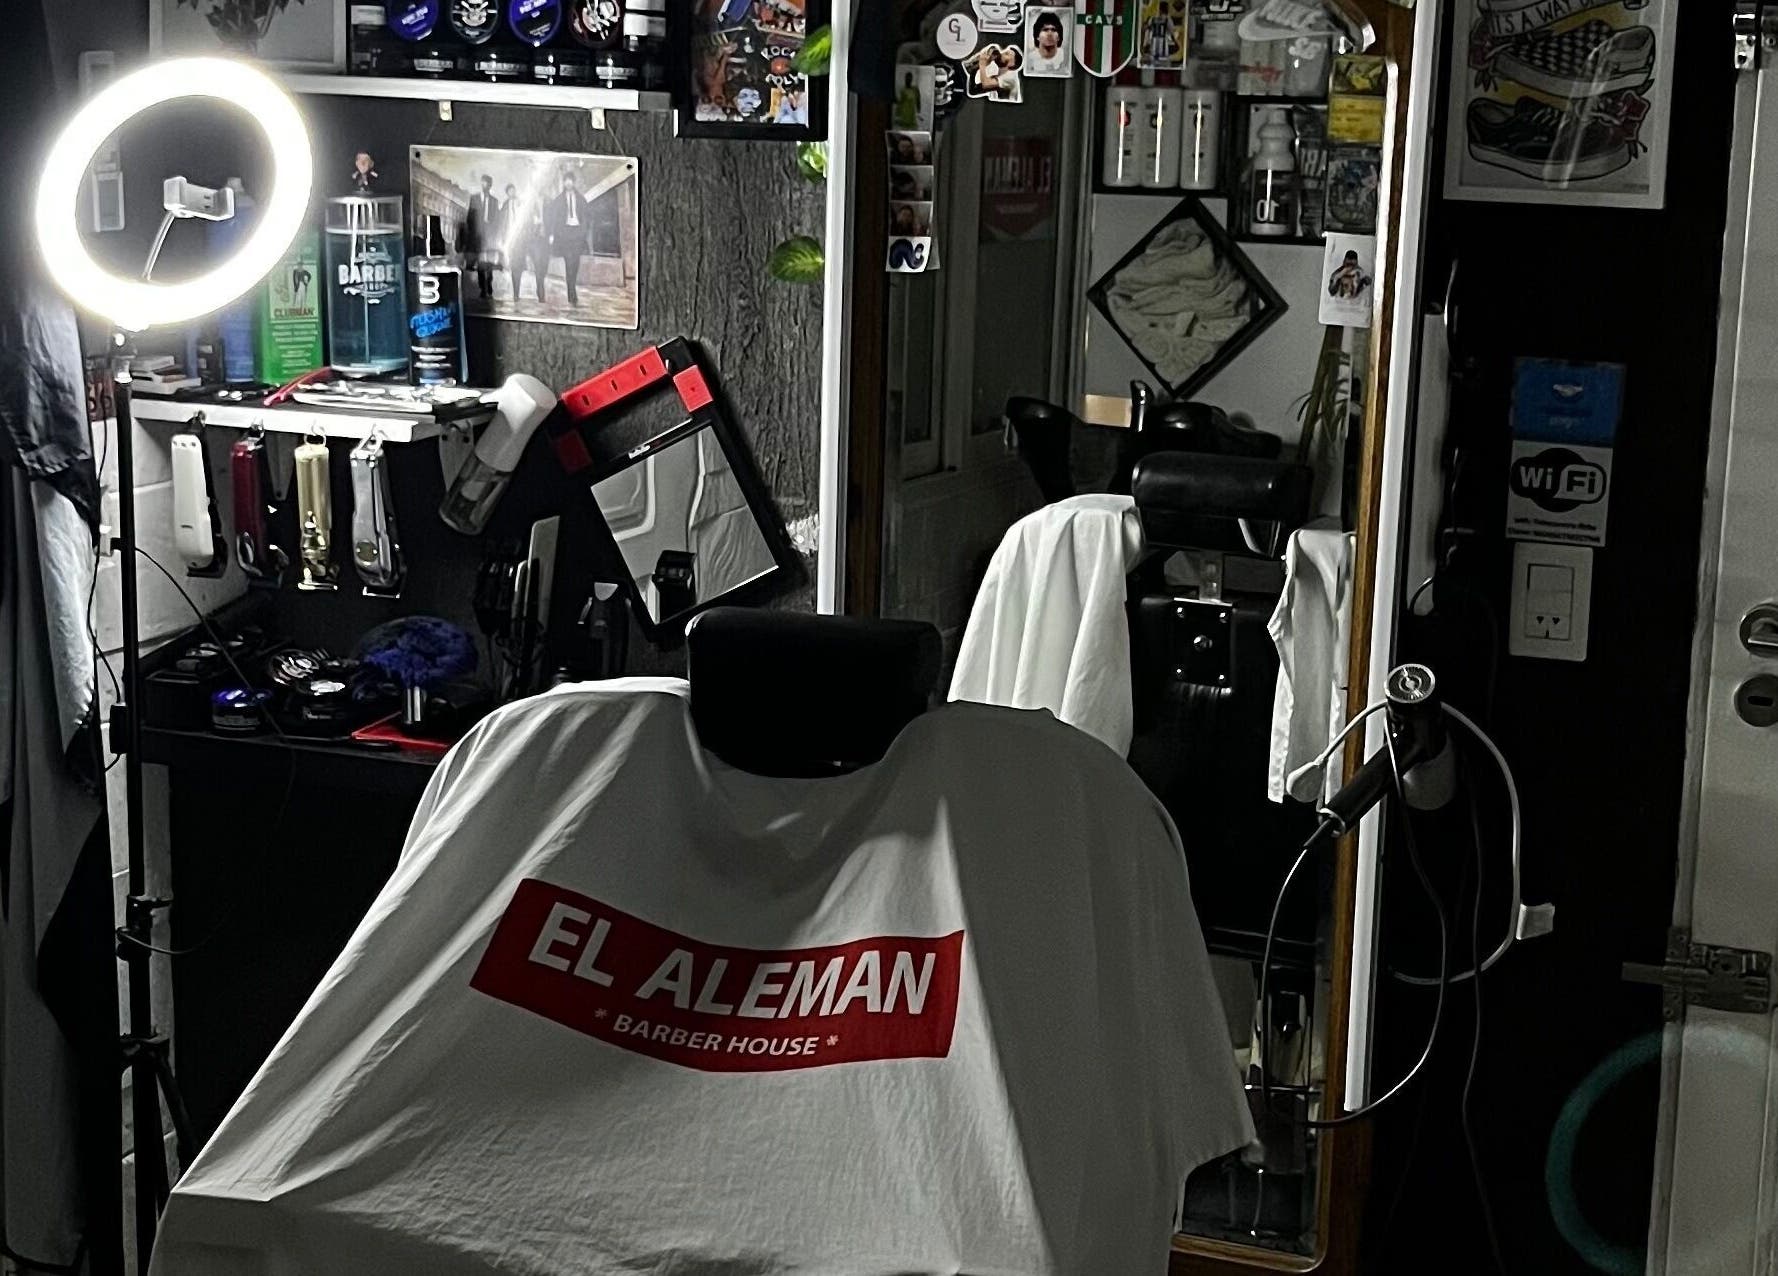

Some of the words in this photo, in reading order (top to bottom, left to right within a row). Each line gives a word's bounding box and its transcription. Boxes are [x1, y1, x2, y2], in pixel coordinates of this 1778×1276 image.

[528, 901, 615, 988] EL
[635, 949, 936, 1020] ALEMAN
[613, 1014, 723, 1051] BARBER
[726, 1035, 820, 1056] HOUSE
